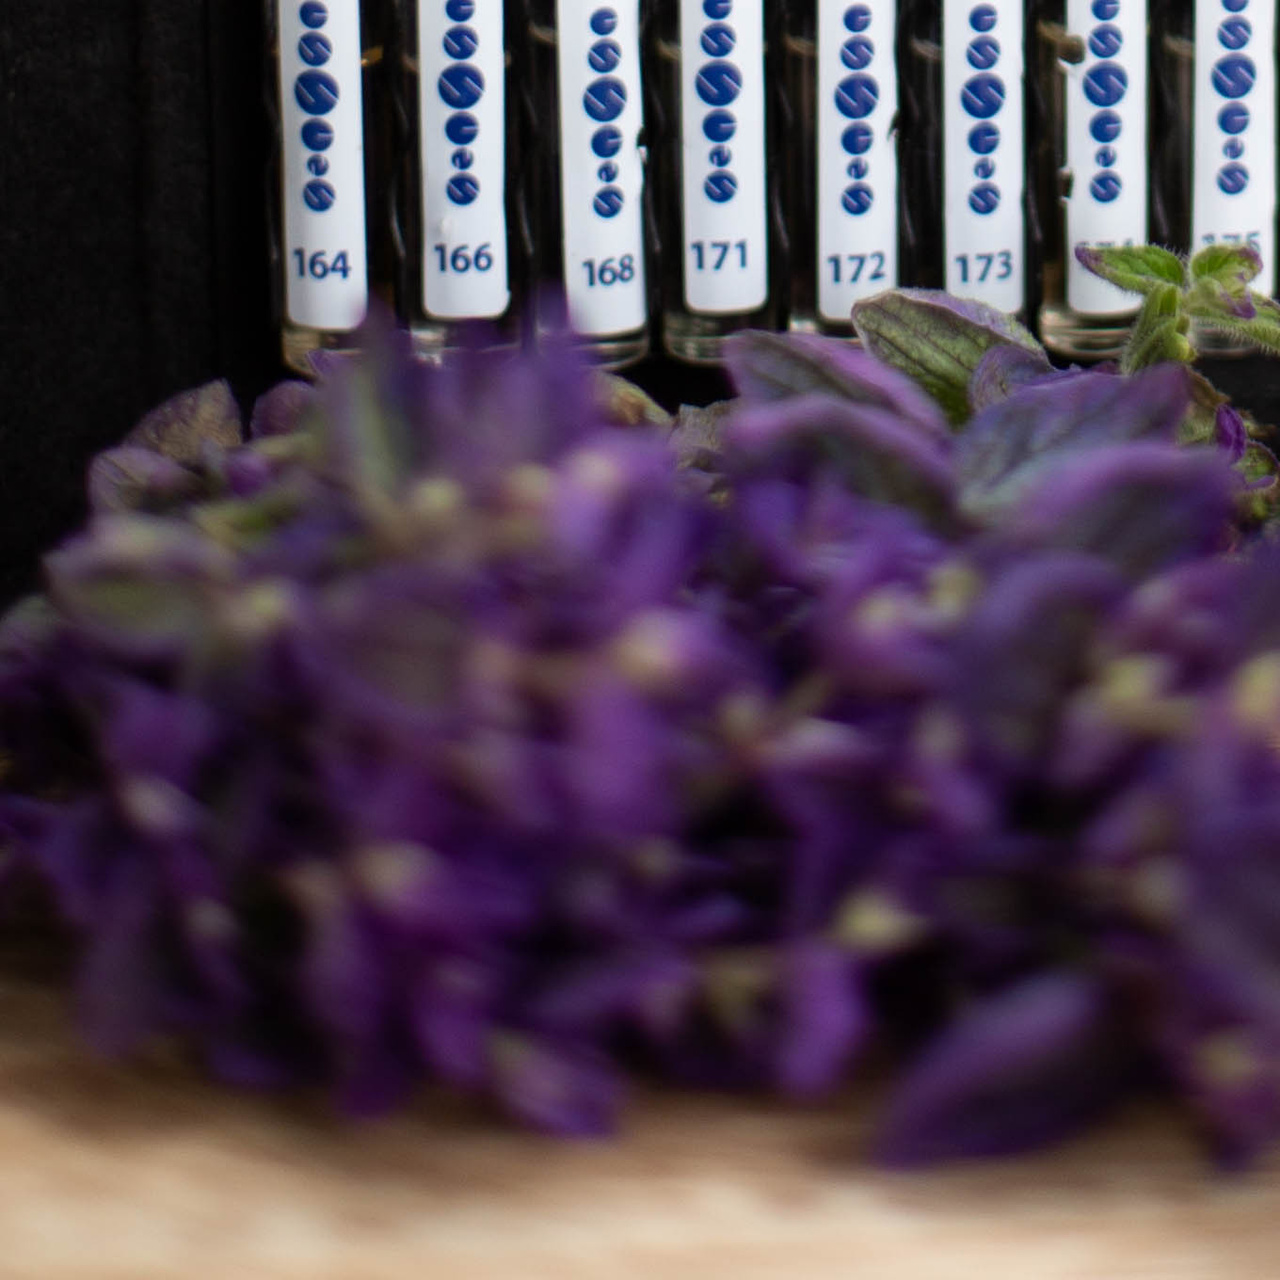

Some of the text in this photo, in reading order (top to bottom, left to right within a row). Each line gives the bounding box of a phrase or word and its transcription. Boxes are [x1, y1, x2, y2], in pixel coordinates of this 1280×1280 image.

[291, 246, 350, 281] 164
[433, 243, 493, 274] 166
[582, 255, 634, 288] 168
[690, 241, 747, 272] 171
[827, 253, 885, 285] 172
[955, 251, 1013, 284] 173
